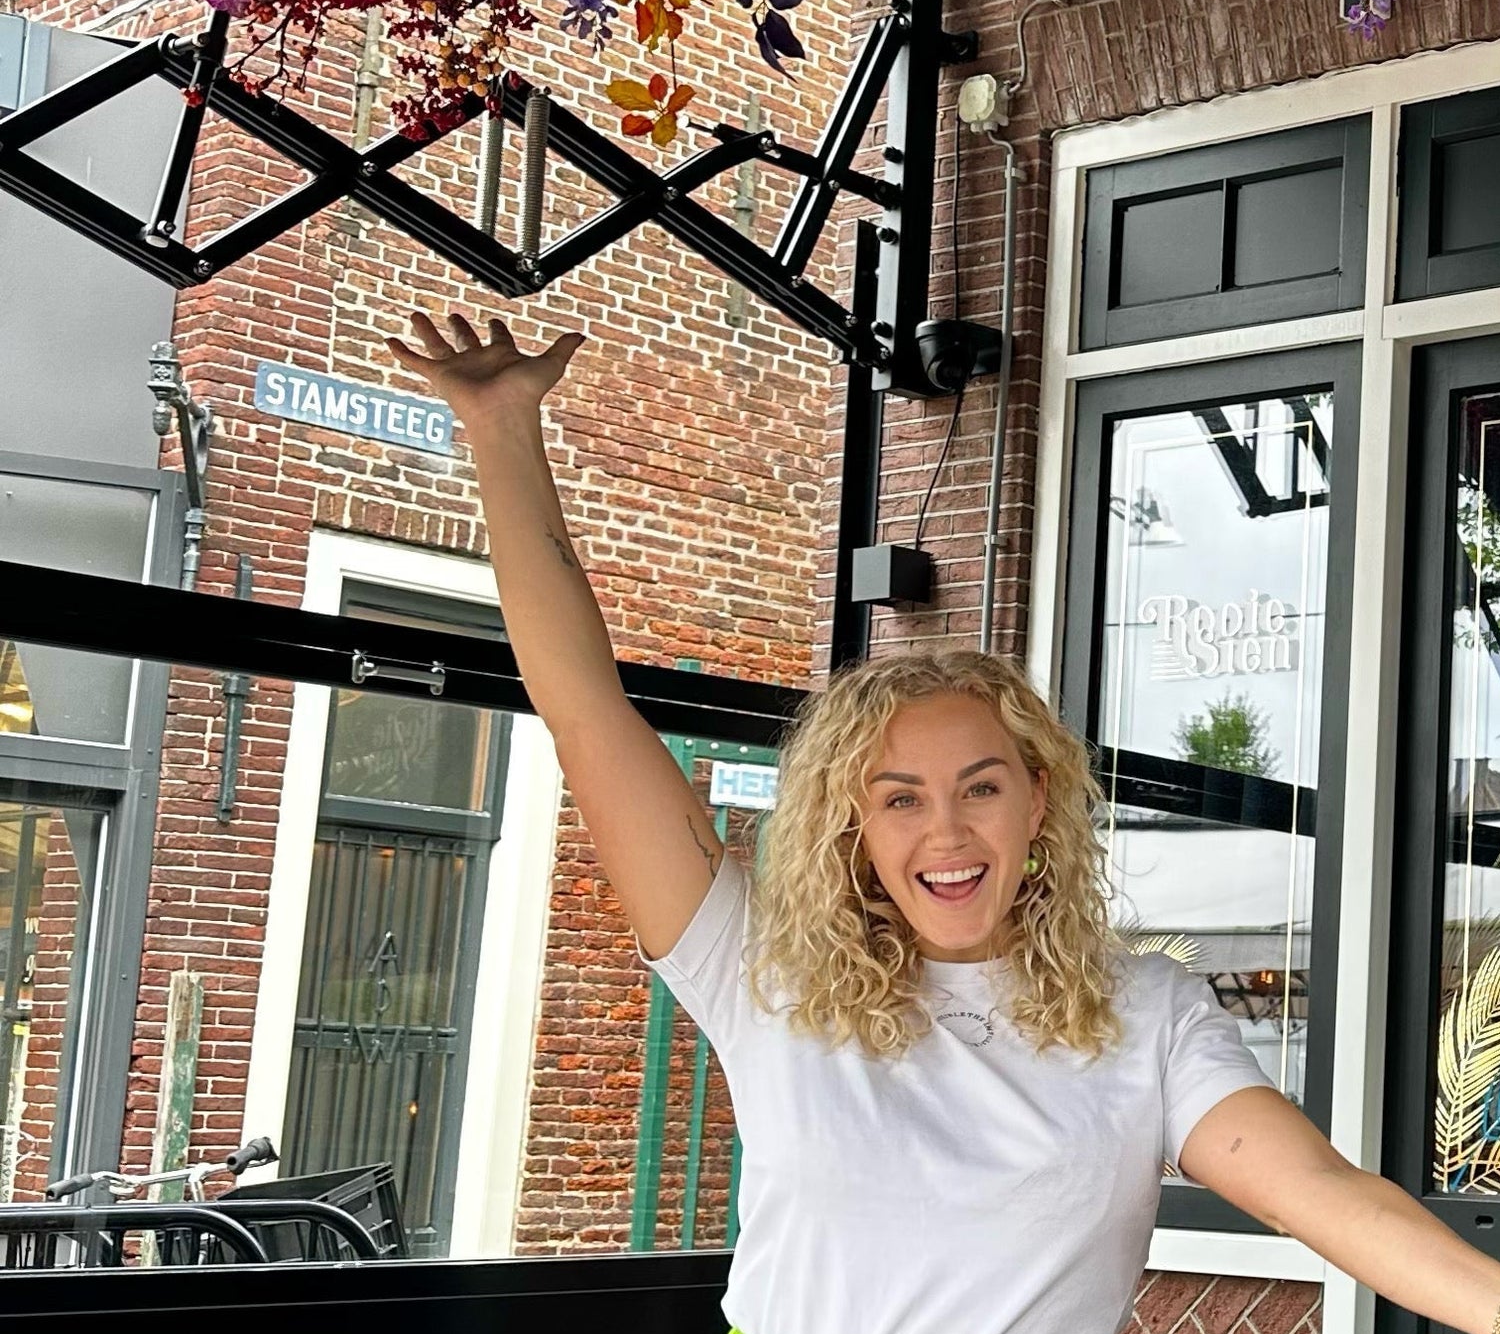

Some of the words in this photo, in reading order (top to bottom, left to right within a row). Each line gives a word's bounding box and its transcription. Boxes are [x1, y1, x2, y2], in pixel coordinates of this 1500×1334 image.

[264, 372, 446, 444] STAMSTEEG
[1138, 588, 1286, 650] Rooie
[1186, 626, 1292, 678] Sien
